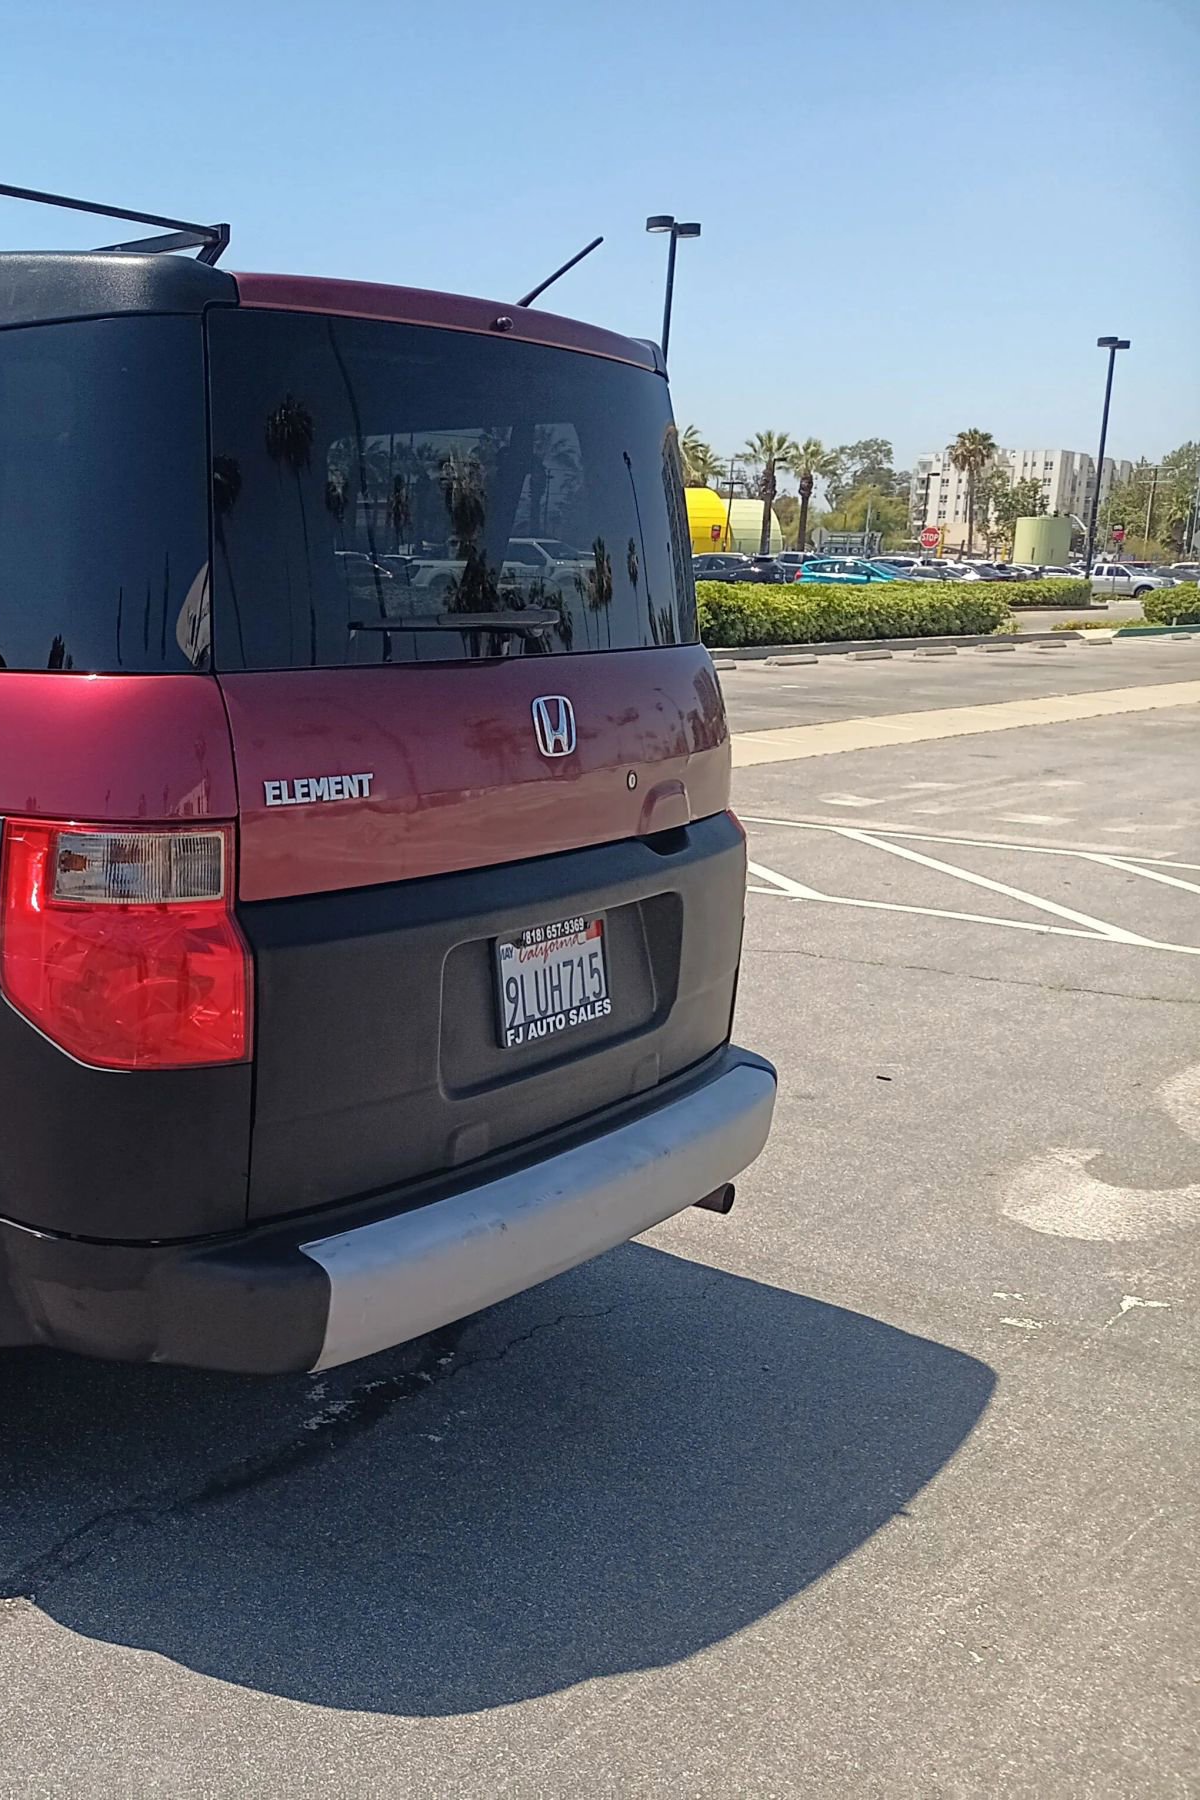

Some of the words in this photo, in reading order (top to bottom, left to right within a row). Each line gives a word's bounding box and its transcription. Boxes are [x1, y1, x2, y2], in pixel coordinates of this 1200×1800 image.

[921, 533, 939, 542] STOP
[264, 773, 374, 806] ELEMENT
[546, 917, 585, 940] 657-9369
[518, 934, 586, 964] California
[505, 951, 603, 1028] 9LUH715
[506, 1026, 523, 1047] FJ
[528, 1014, 566, 1041] AUTO
[569, 998, 612, 1026] SALES
